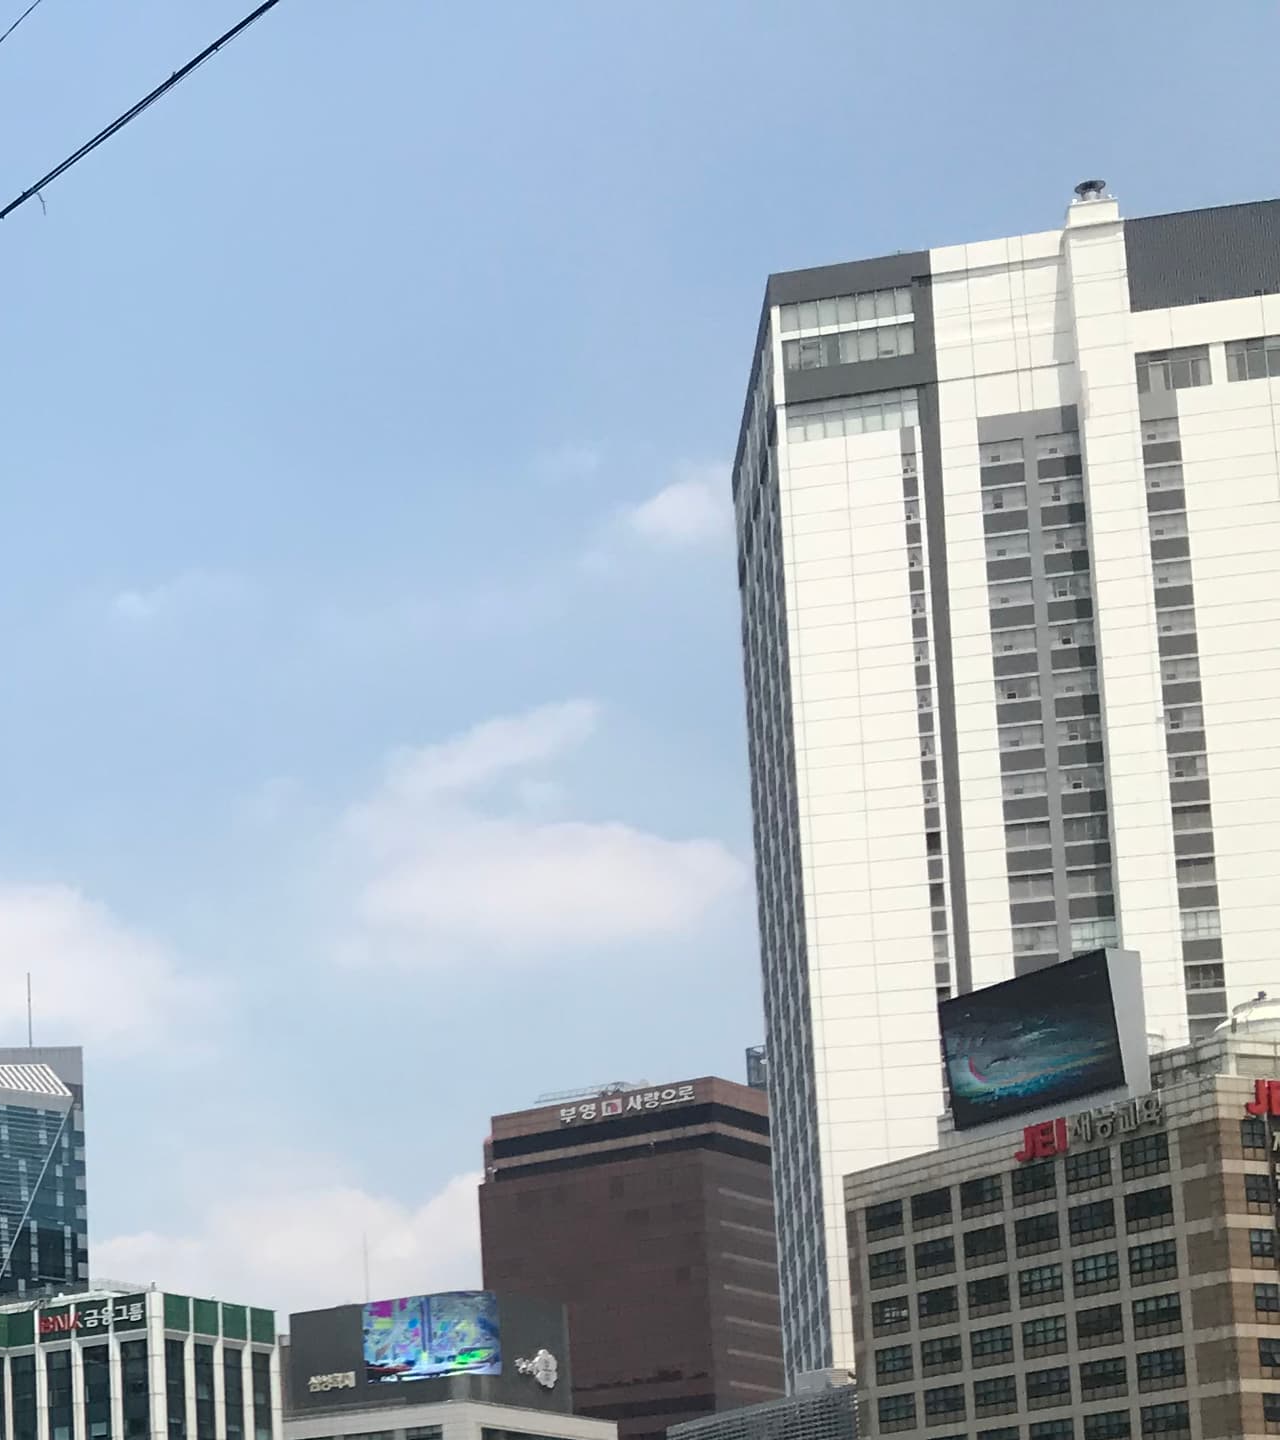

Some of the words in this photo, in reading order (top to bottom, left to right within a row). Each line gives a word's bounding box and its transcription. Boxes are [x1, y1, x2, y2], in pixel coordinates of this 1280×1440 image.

[560, 1102, 596, 1123] 부영
[626, 1085, 695, 1111] 사랑으로
[1015, 1117, 1067, 1162] JEI
[1069, 1090, 1162, 1143] 재능교육
[39, 1312, 83, 1333] BNK
[84, 1302, 144, 1327] 금융그룹
